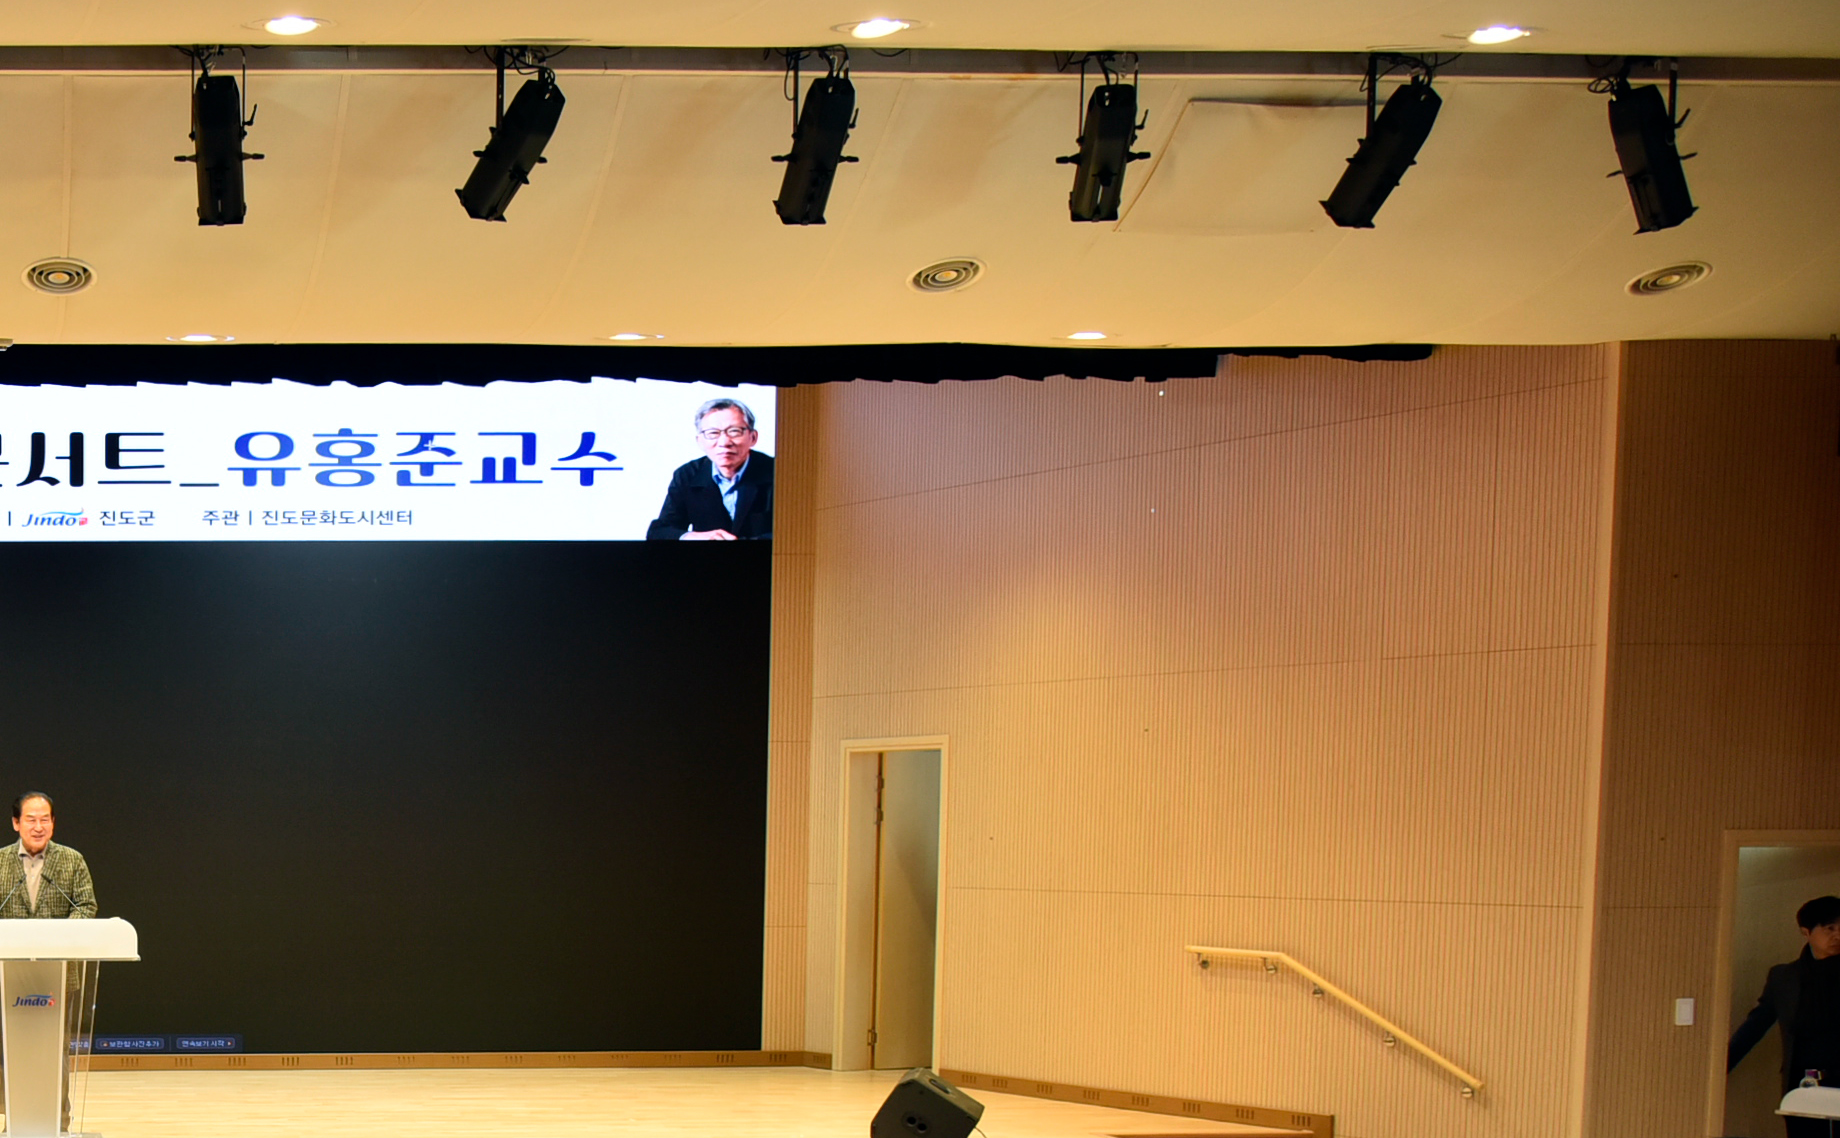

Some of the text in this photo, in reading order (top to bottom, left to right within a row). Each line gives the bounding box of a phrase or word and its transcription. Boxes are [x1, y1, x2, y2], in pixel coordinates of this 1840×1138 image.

[99, 510, 156, 526] 진도군
[202, 509, 241, 526] 주관
[262, 509, 414, 526] 진도문화도시센터
[12, 996, 48, 1007] Jindo
